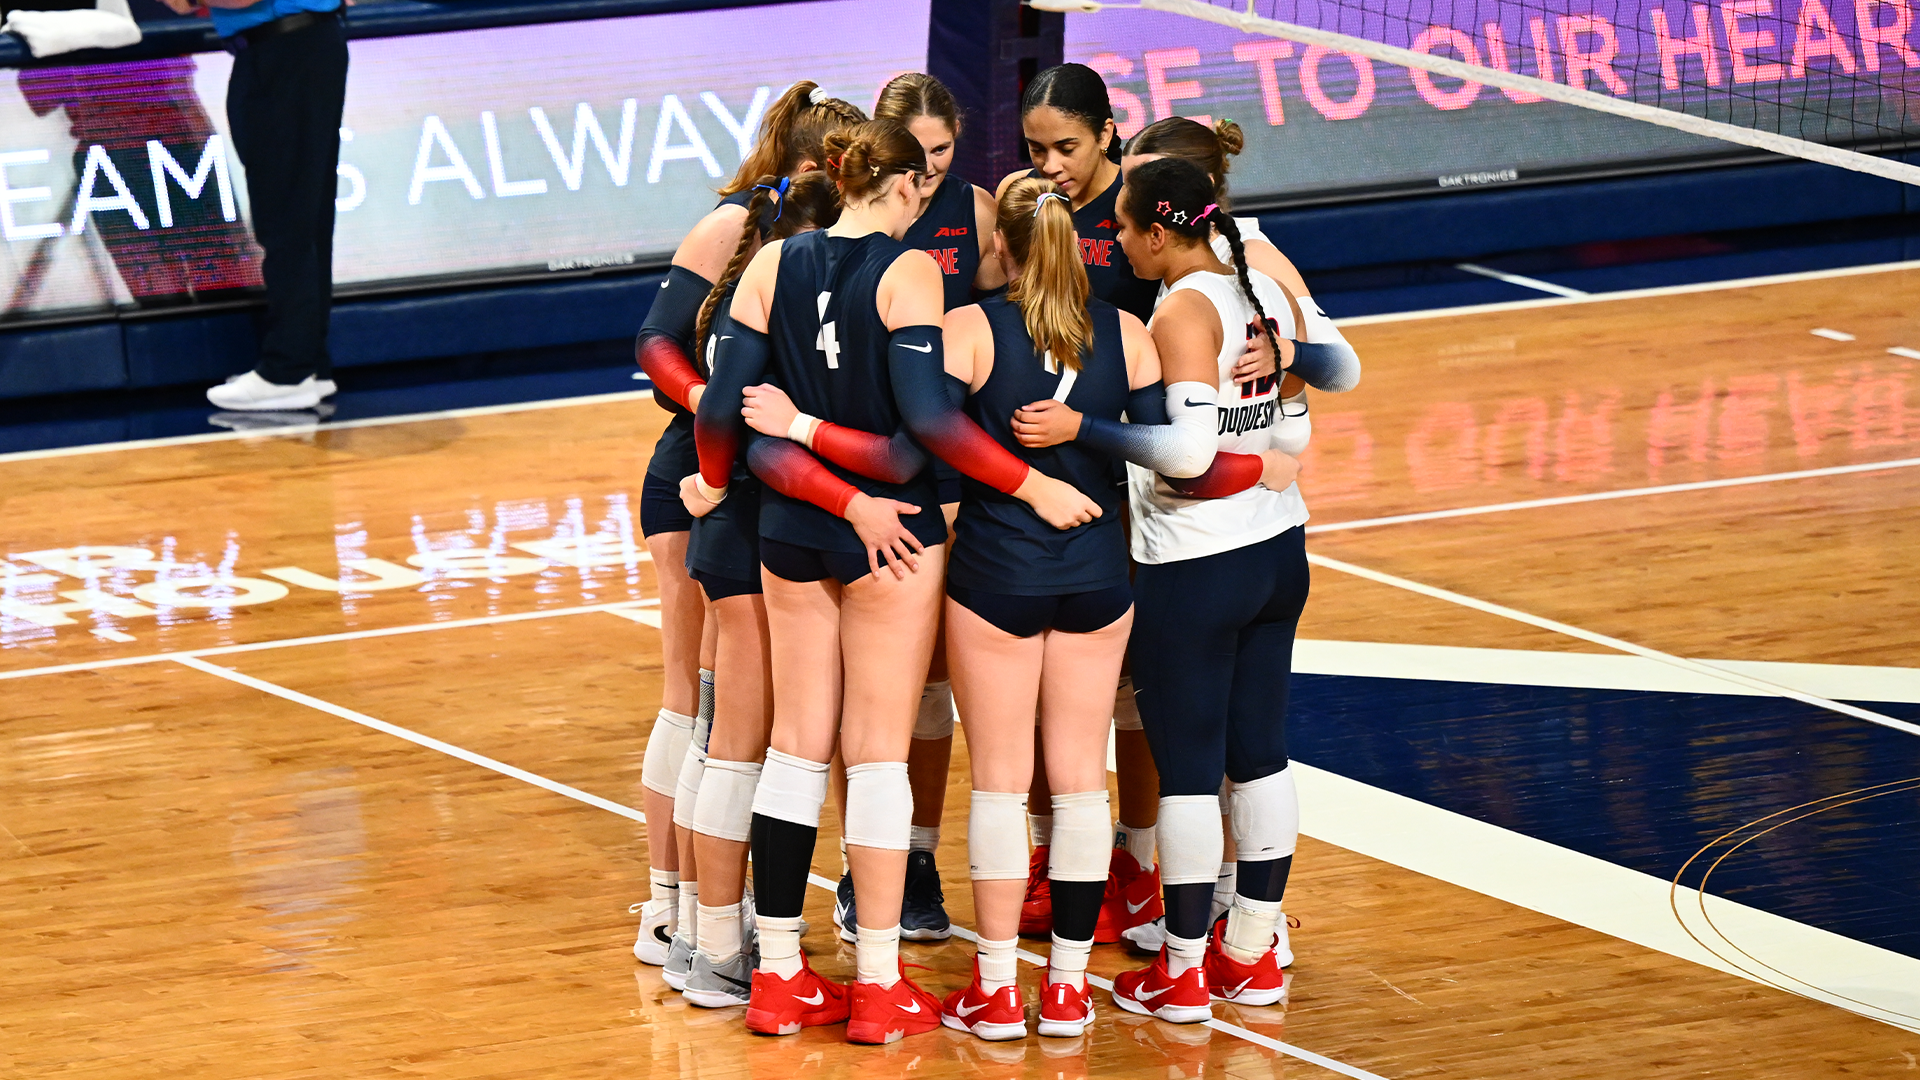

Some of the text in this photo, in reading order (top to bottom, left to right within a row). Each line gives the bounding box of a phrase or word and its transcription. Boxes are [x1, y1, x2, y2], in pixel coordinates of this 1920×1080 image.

[1088, 0, 1920, 139] SE TO OUR HEAR
[0, 135, 236, 240] EAM
[408, 84, 795, 204] ALWAY
[926, 248, 959, 275] NE
[816, 291, 840, 369] 4
